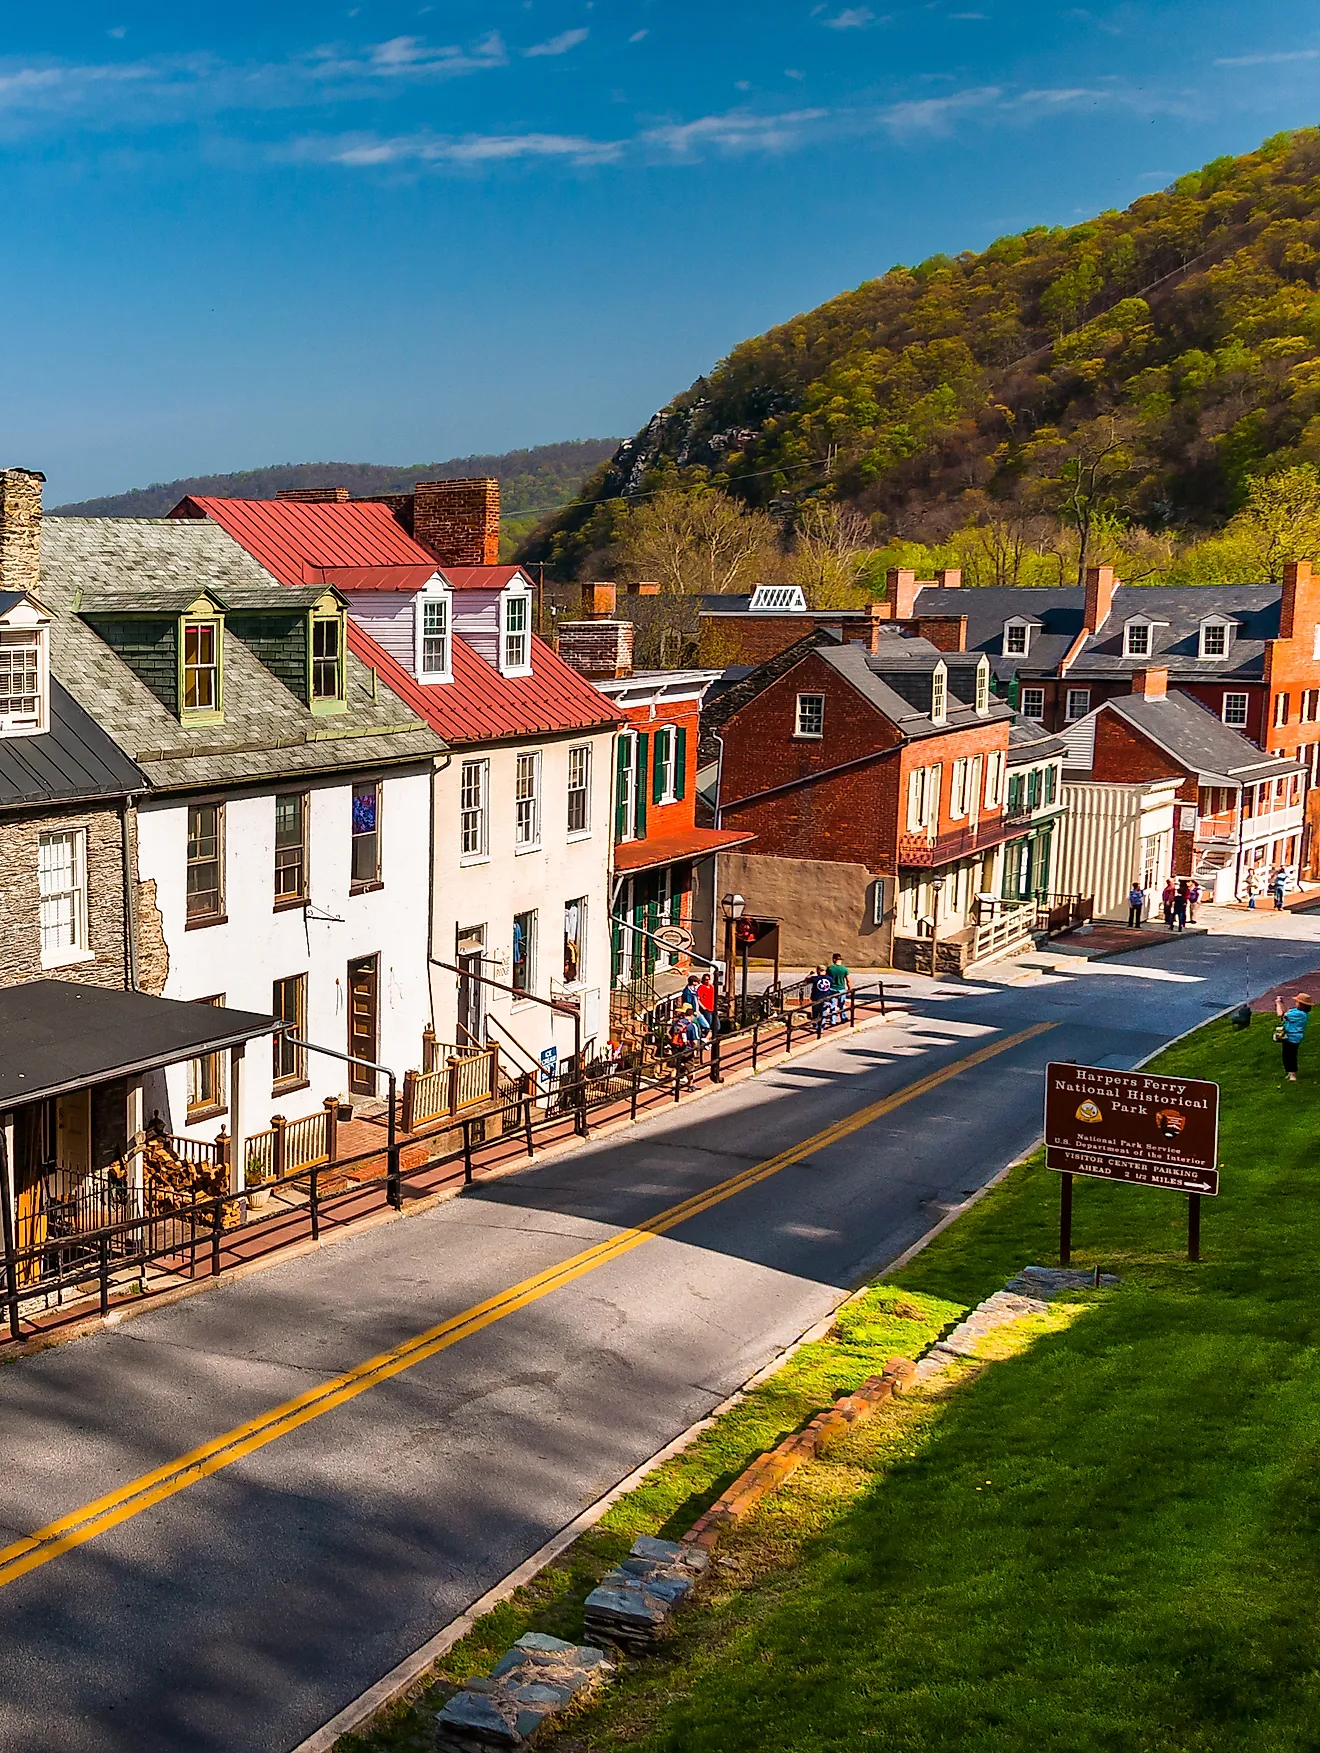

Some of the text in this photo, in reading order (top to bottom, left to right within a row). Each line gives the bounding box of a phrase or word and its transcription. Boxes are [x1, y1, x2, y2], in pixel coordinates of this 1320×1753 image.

[1055, 1080, 1208, 1109] National Historical
[1076, 1069, 1187, 1095] Harpers Ferry
[1111, 1101, 1148, 1115] Park
[1054, 1137, 1072, 1145] U.S.
[1075, 1140, 1130, 1154] Department
[1147, 1151, 1162, 1159] the
[1166, 1153, 1206, 1165] Interior
[1077, 1133, 1181, 1154] National Park Service
[1064, 1151, 1199, 1178] VISITOR CENTER PARKING
[1078, 1163, 1112, 1175] AHEAD
[1151, 1175, 1183, 1186] MILES
